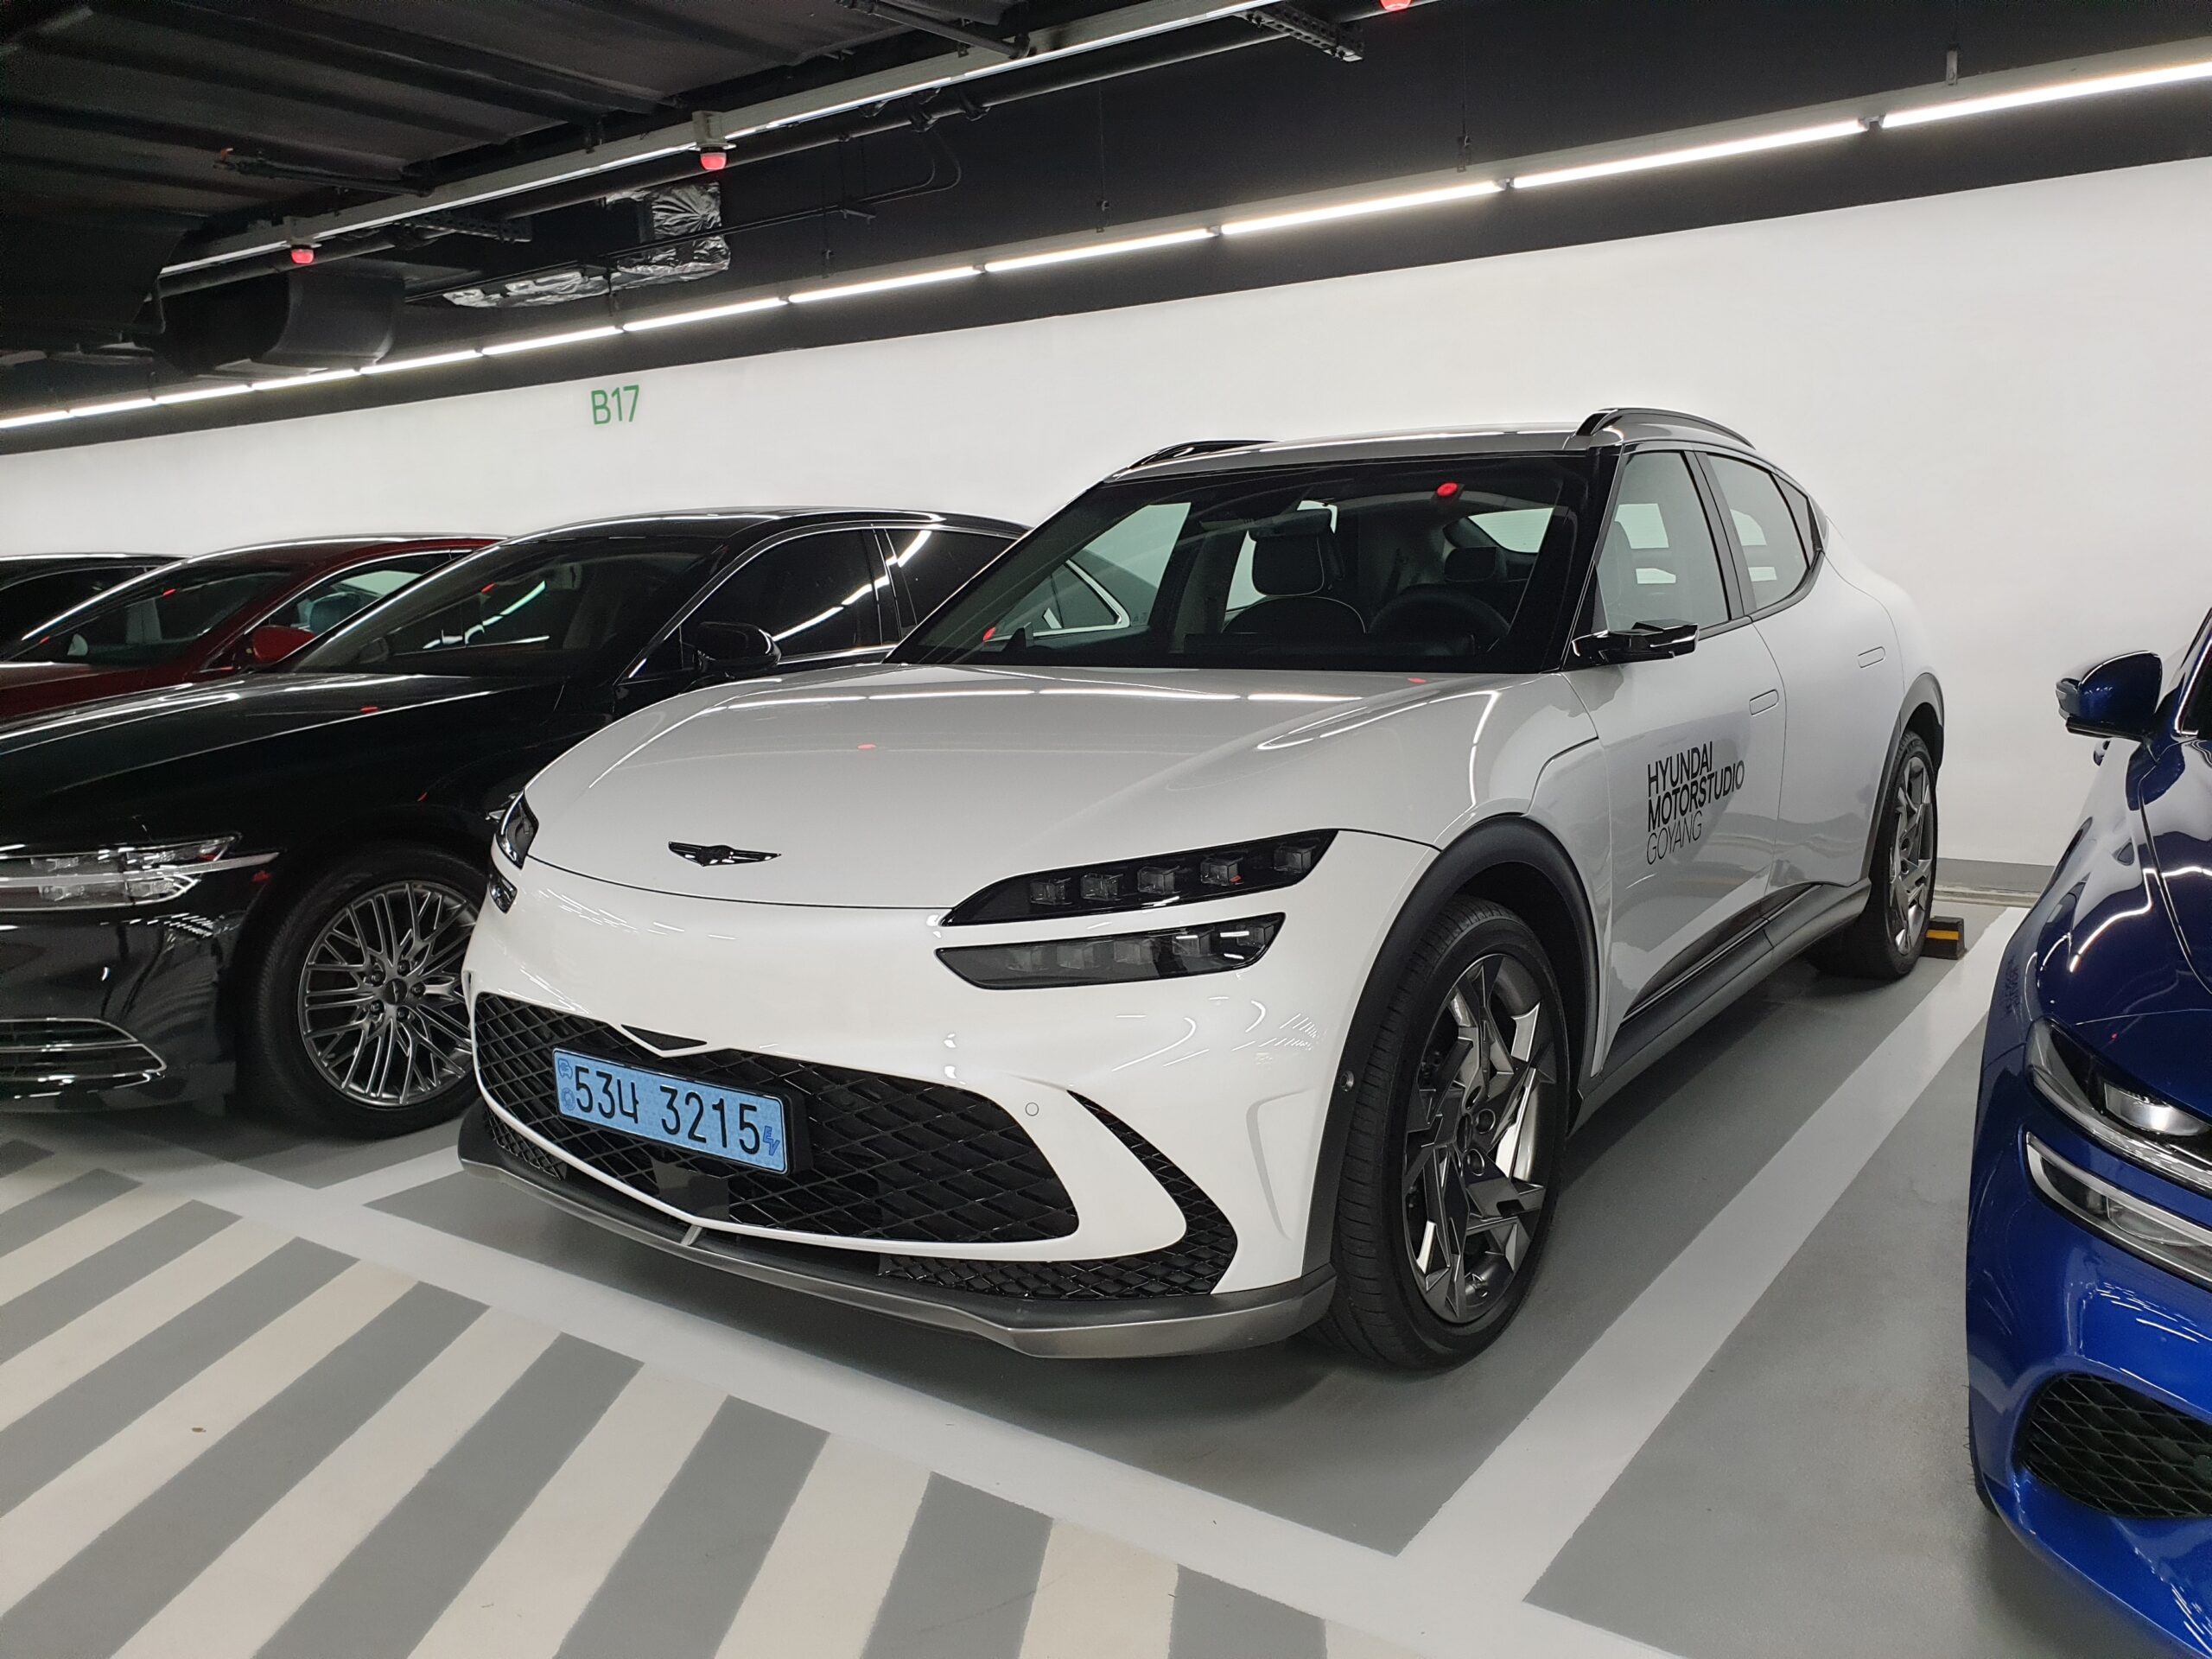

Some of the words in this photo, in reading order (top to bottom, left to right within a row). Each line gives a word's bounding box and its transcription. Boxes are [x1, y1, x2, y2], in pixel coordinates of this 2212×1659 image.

[591, 385, 639, 425] B17
[1647, 741, 1713, 798] HYUNDAI
[1648, 760, 1745, 832] MOTORSTUDIO
[1646, 810, 1703, 865] GOYANG
[575, 1065, 639, 1124] 53나
[659, 1084, 760, 1155] 3215
[762, 1125, 781, 1157] EV
